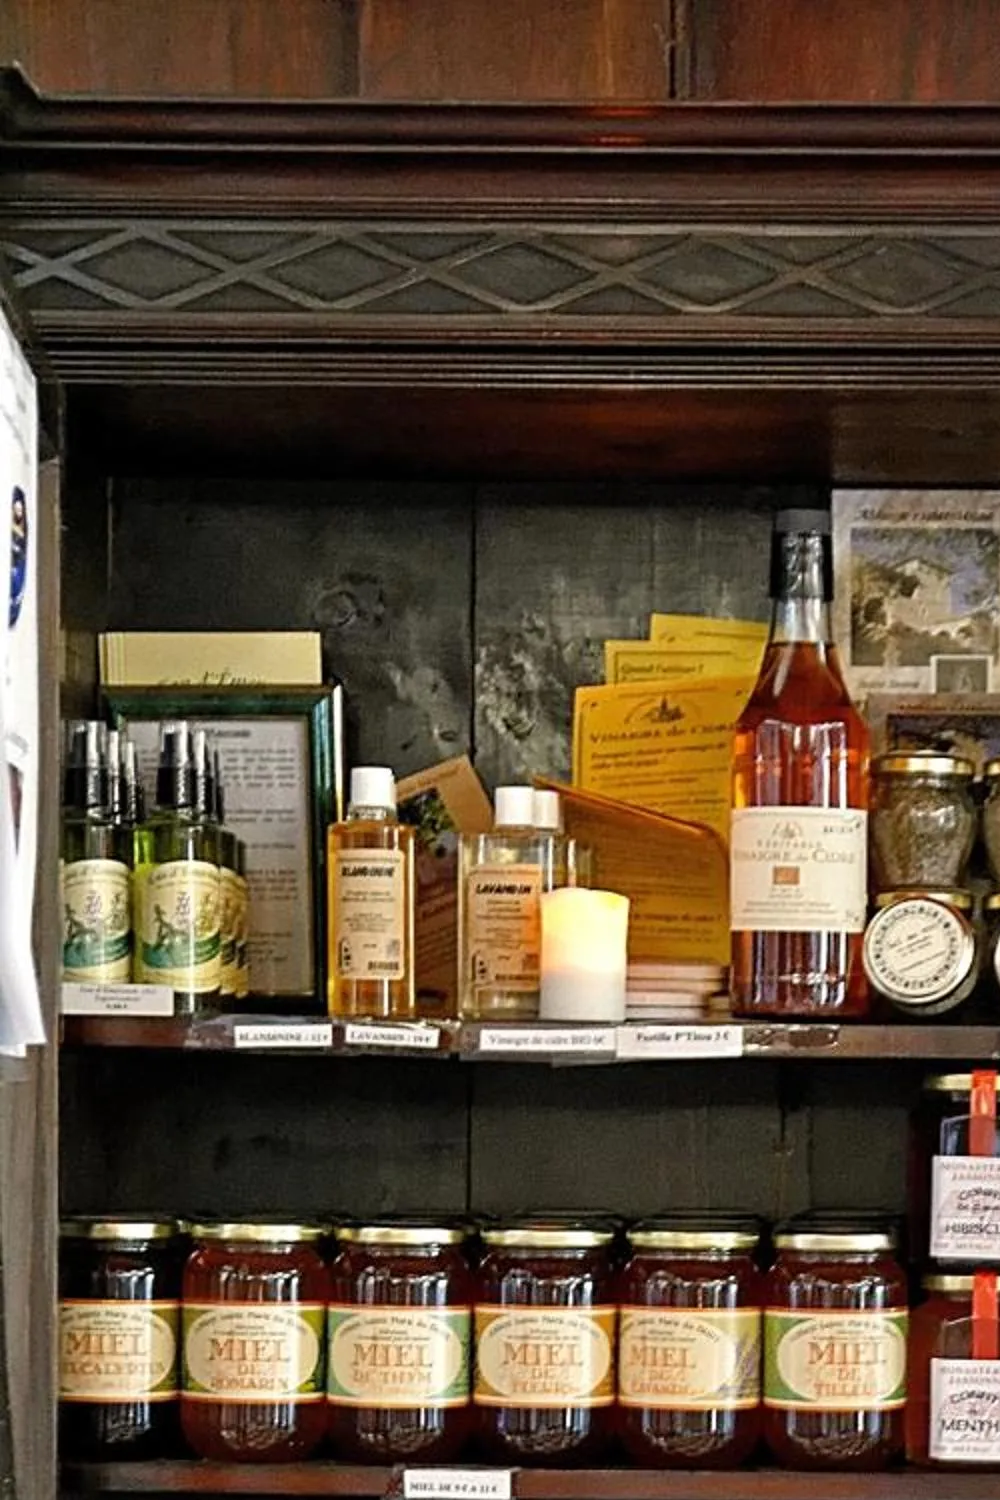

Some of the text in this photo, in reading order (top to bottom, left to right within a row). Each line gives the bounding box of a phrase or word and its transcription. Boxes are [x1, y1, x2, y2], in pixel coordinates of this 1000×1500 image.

[475, 884, 532, 895] LAVANDIN
[66, 1332, 147, 1357] MIEL
[208, 1338, 292, 1362] MIEL
[352, 1342, 433, 1367] MIEL
[502, 1342, 584, 1367] MIEL
[808, 1340, 887, 1365] MIEL
[629, 1346, 696, 1369] MIEL
[210, 1376, 290, 1390] ROMARIN
[379, 1369, 432, 1384] THYM
[410, 1482, 435, 1493] MIEL
